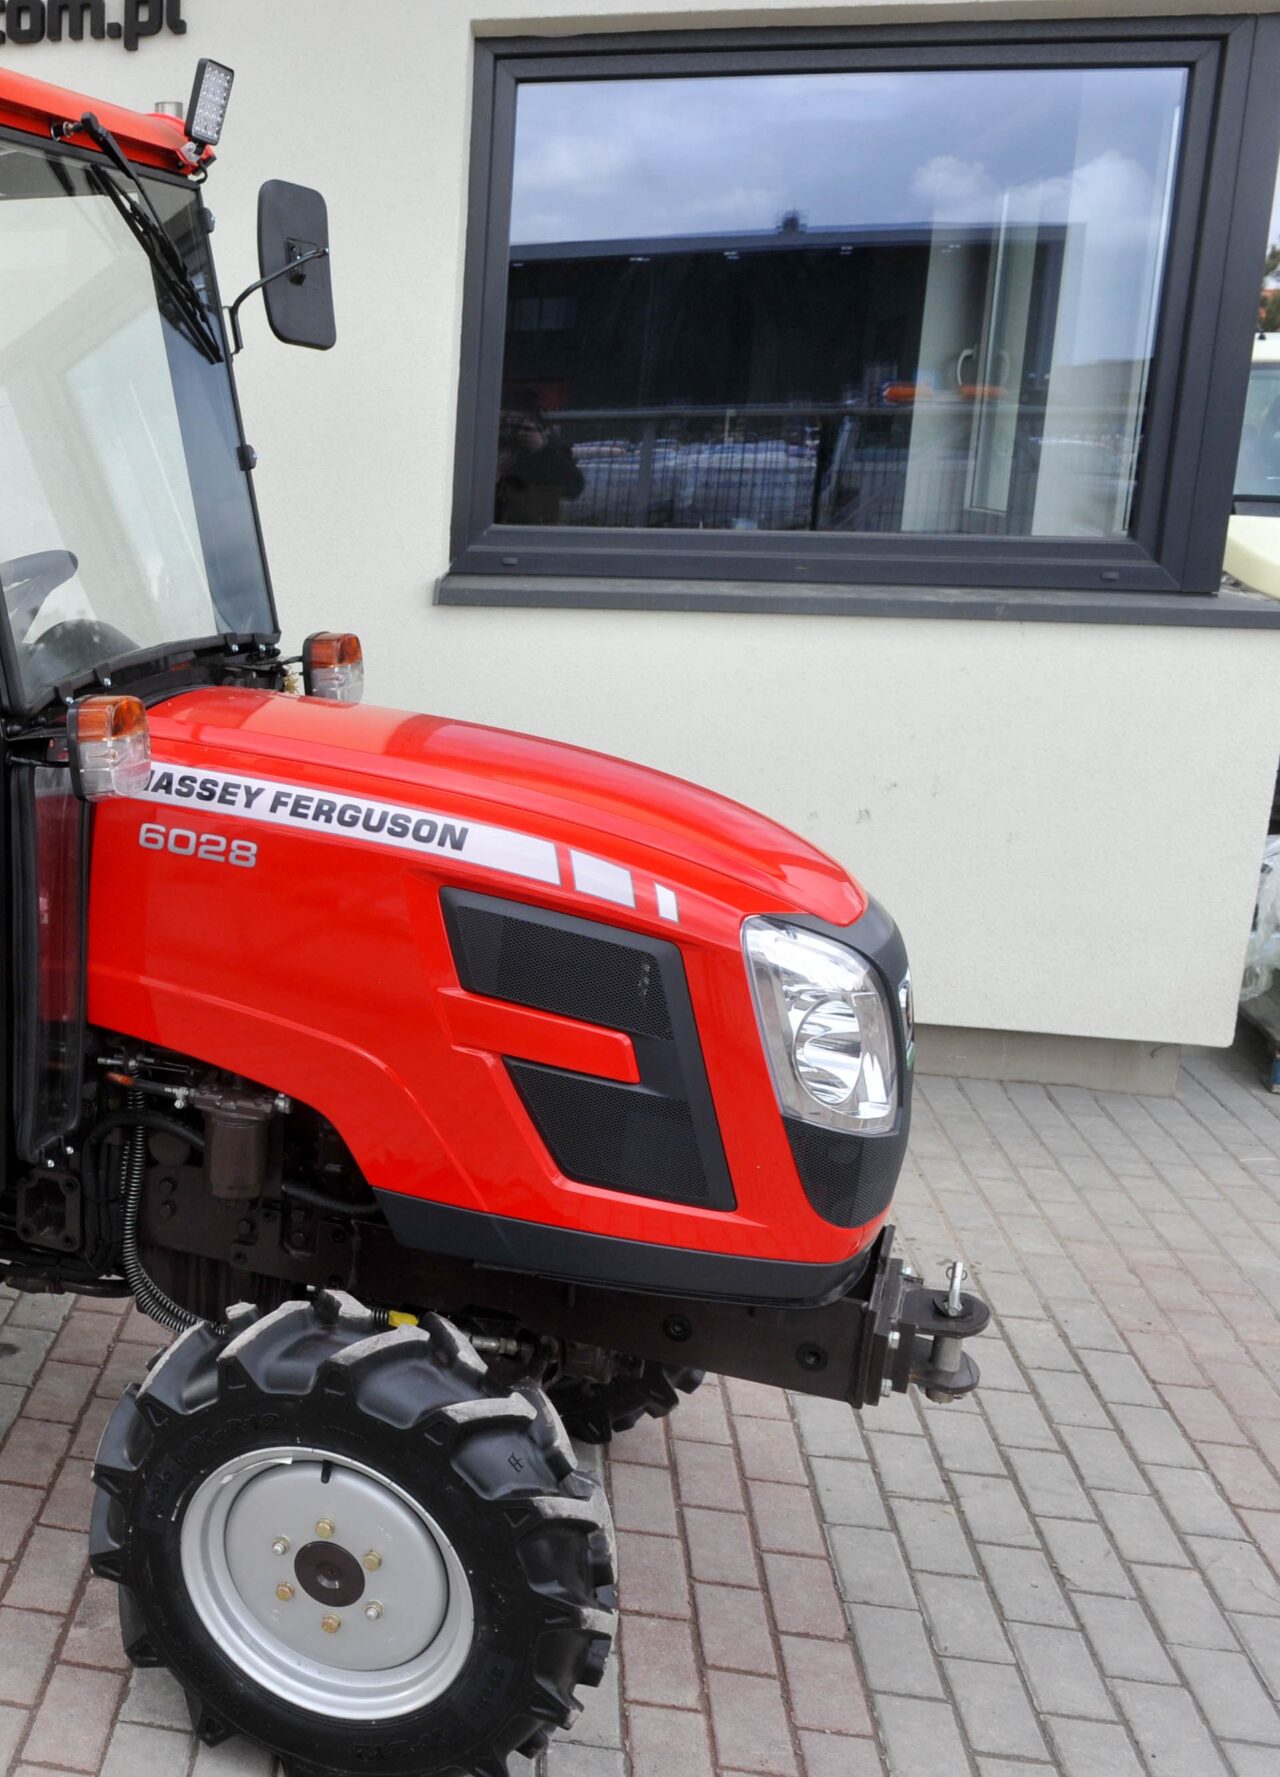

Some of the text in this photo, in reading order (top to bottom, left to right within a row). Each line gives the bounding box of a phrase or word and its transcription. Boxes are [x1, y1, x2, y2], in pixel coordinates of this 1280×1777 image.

[144, 770, 469, 851] ASSEY FERGUSON
[138, 822, 257, 868] 6028
